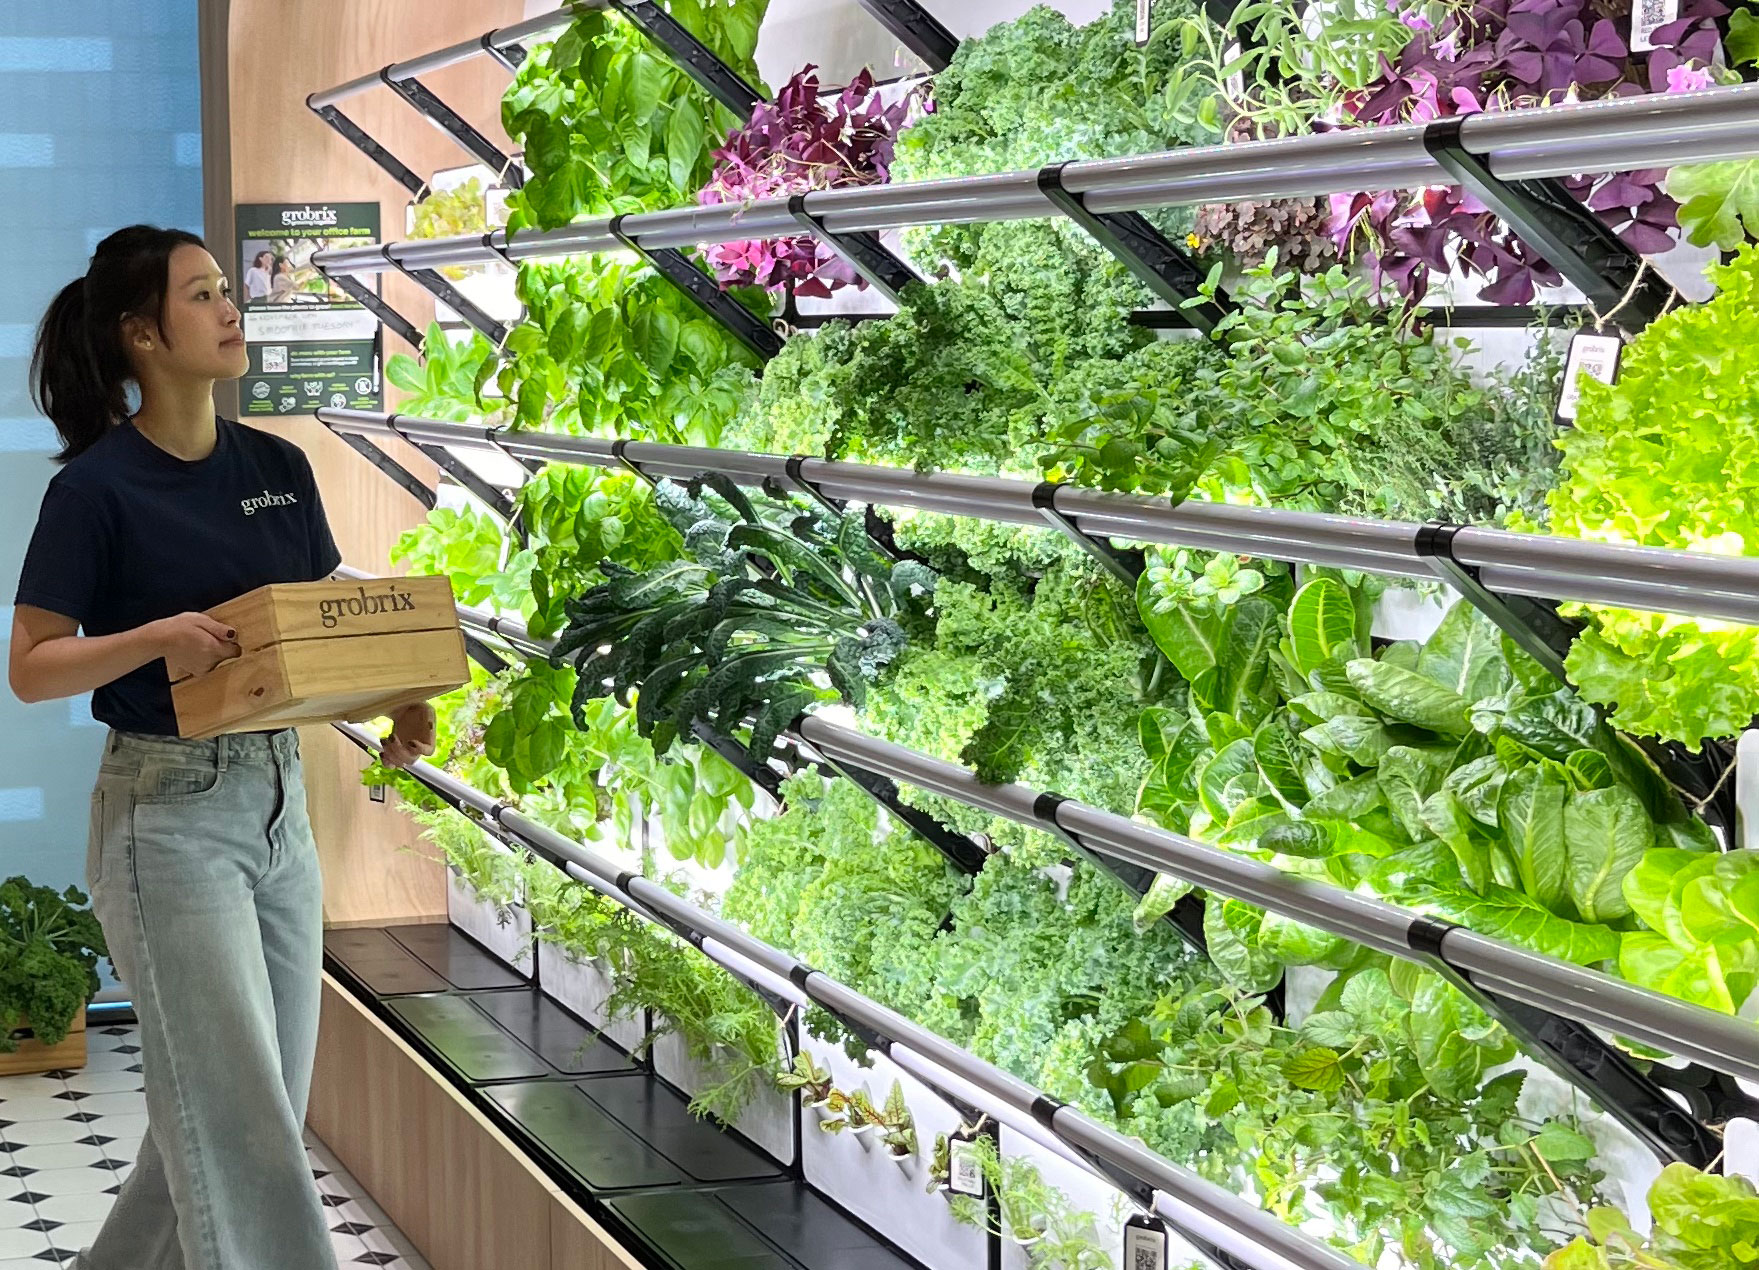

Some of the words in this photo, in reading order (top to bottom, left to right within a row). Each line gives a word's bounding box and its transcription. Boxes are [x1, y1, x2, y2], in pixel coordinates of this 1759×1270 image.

[281, 206, 338, 226] grobrix
[248, 229, 289, 237] welcome
[291, 228, 301, 237] to
[302, 229, 322, 238] your
[323, 227, 349, 236] office
[350, 227, 371, 235] farm
[257, 322, 306, 336] SMOOTHIE
[241, 490, 298, 516] grobrix
[319, 585, 416, 628] grobrix
